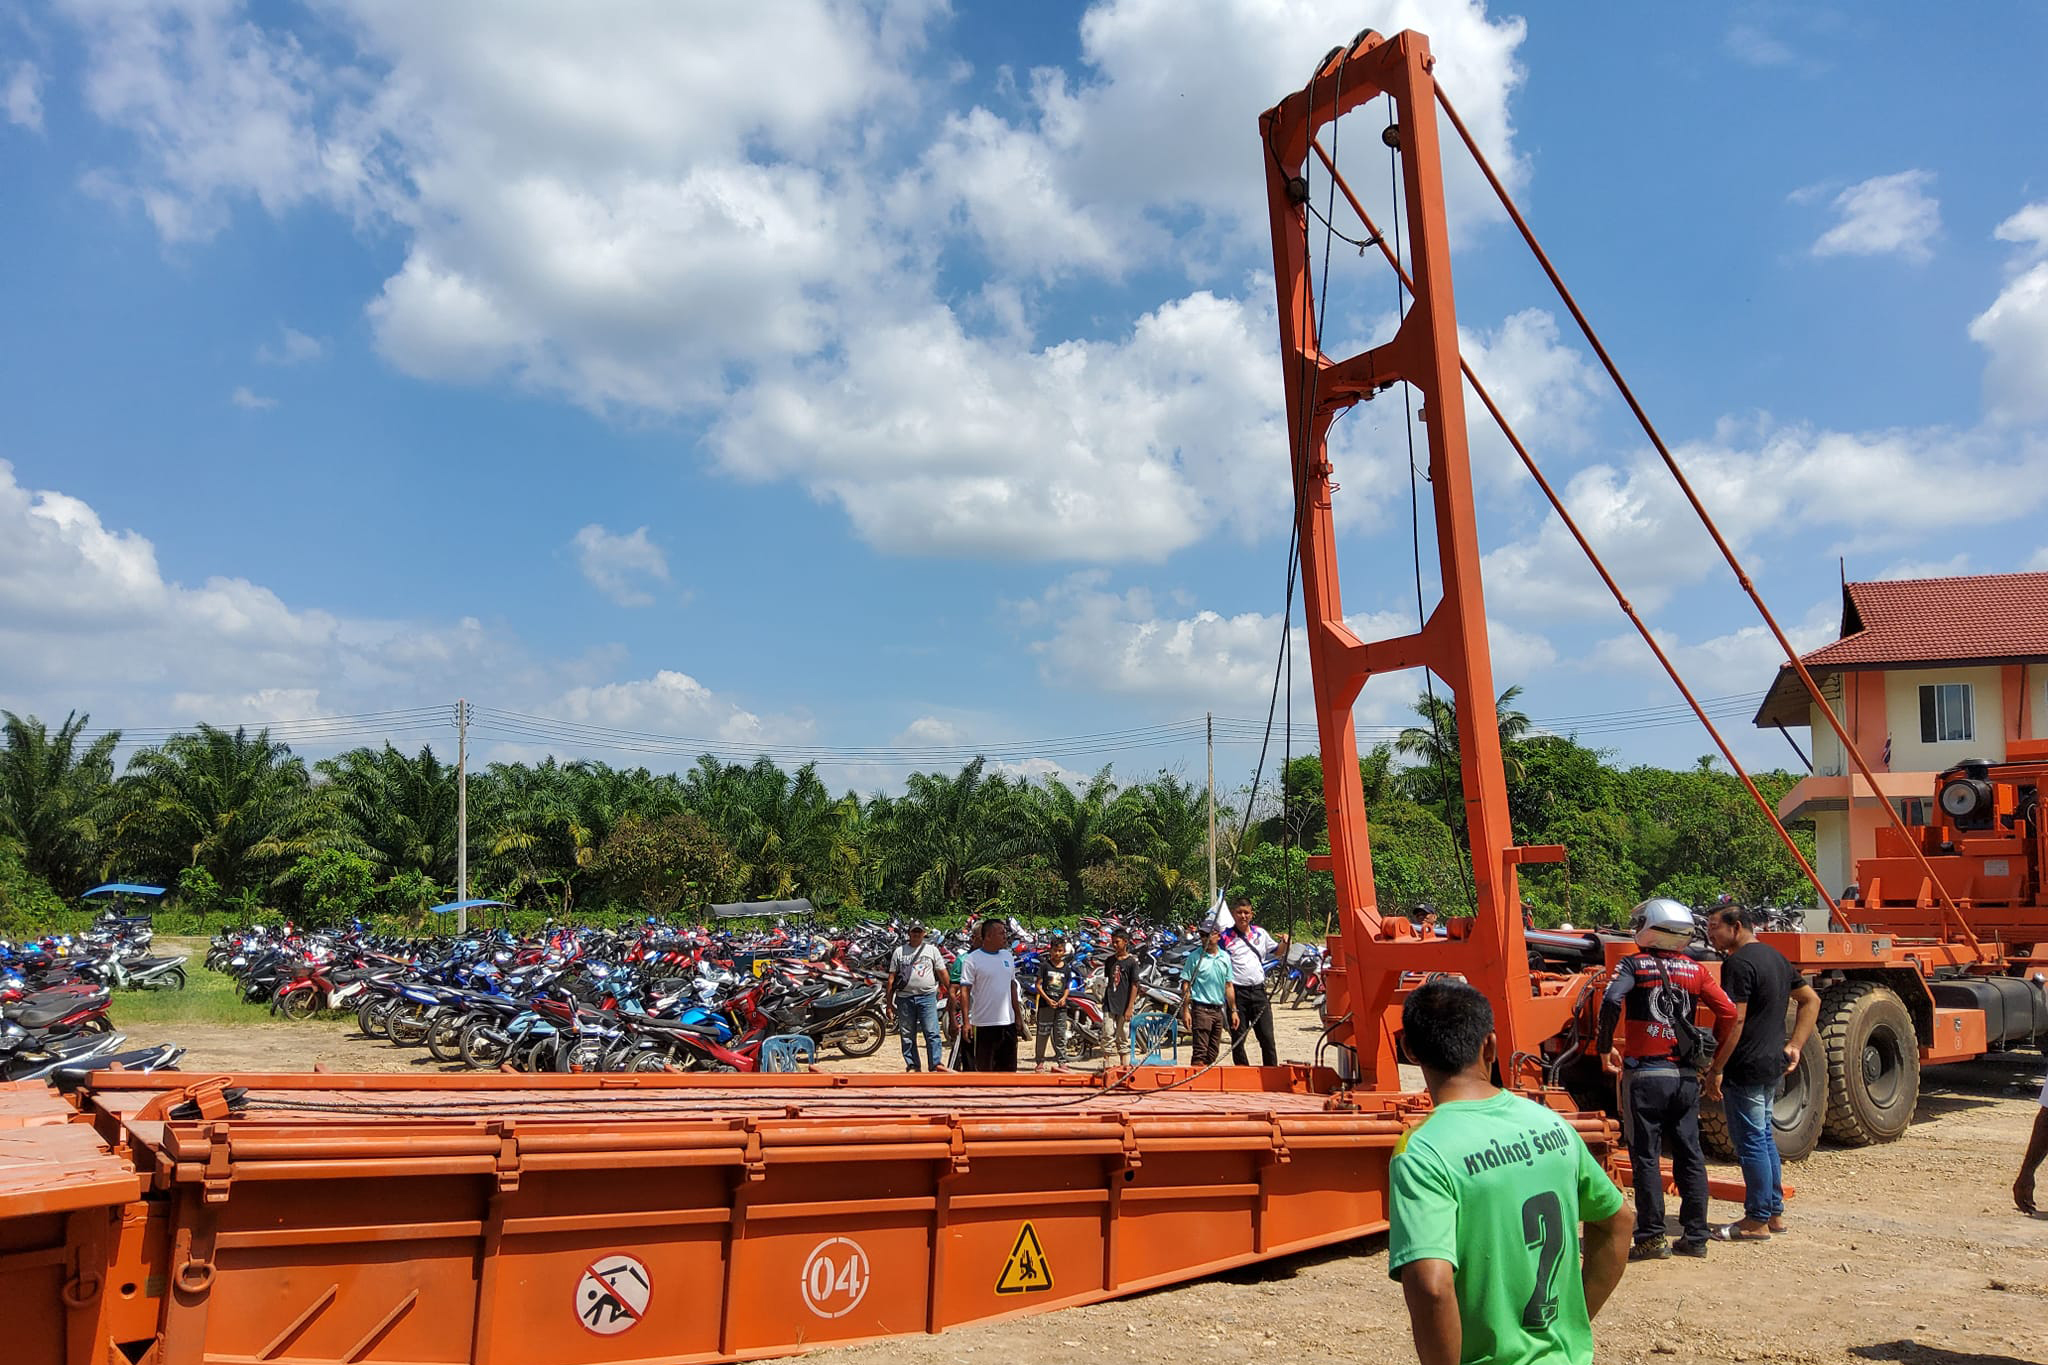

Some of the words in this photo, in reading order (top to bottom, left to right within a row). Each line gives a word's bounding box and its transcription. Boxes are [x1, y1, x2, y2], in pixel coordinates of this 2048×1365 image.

[1463, 1133, 1534, 1176] หาดใหญ่
[811, 1255, 860, 1301] 04
[1521, 1191, 1567, 1333] 2
